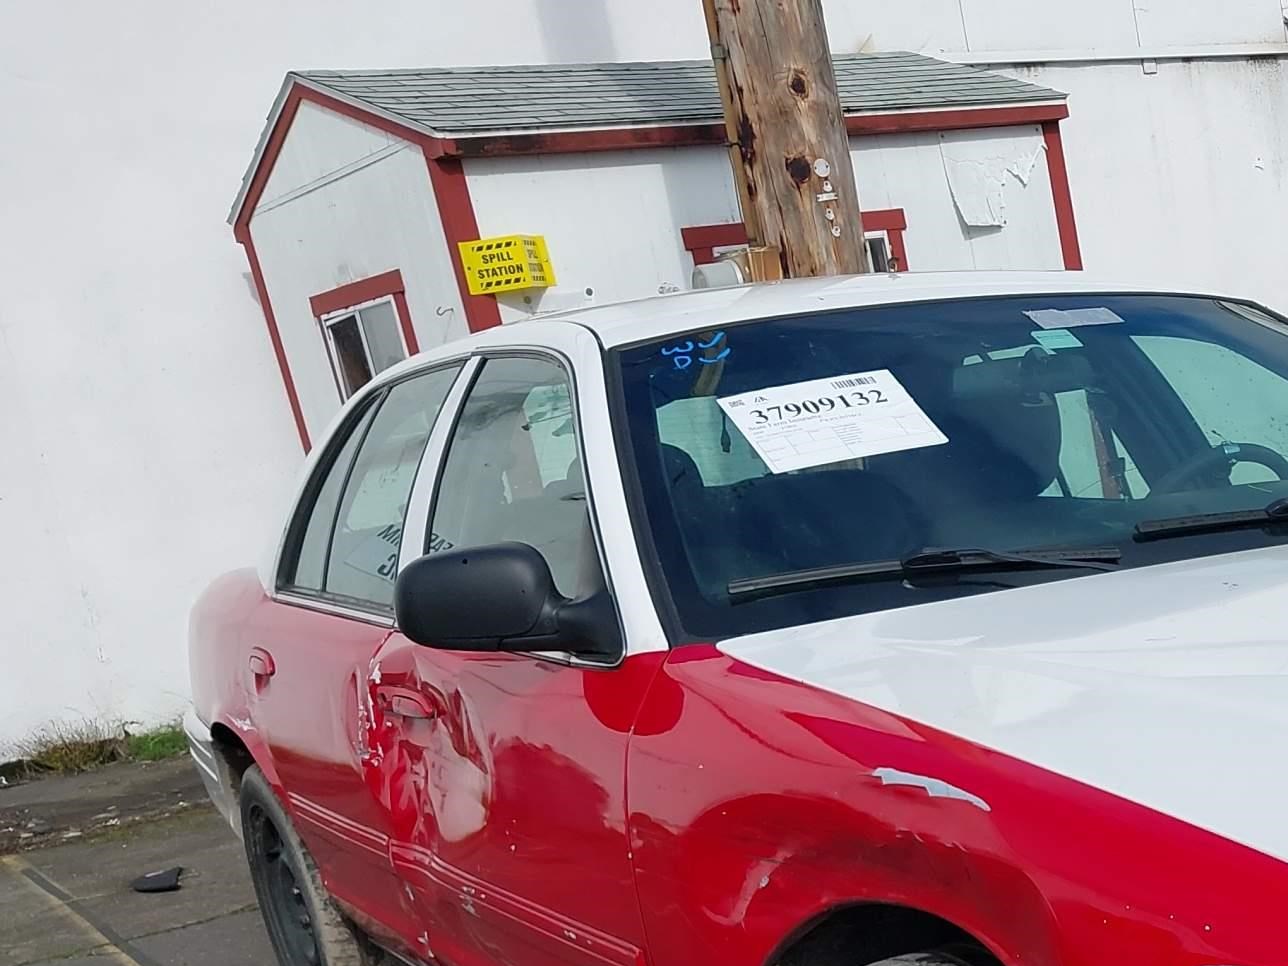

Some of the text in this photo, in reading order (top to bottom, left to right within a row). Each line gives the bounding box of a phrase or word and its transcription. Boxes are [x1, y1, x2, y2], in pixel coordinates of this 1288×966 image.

[481, 251, 513, 265] SPILL
[477, 264, 524, 280] STATION
[749, 389, 889, 425] 37909132
